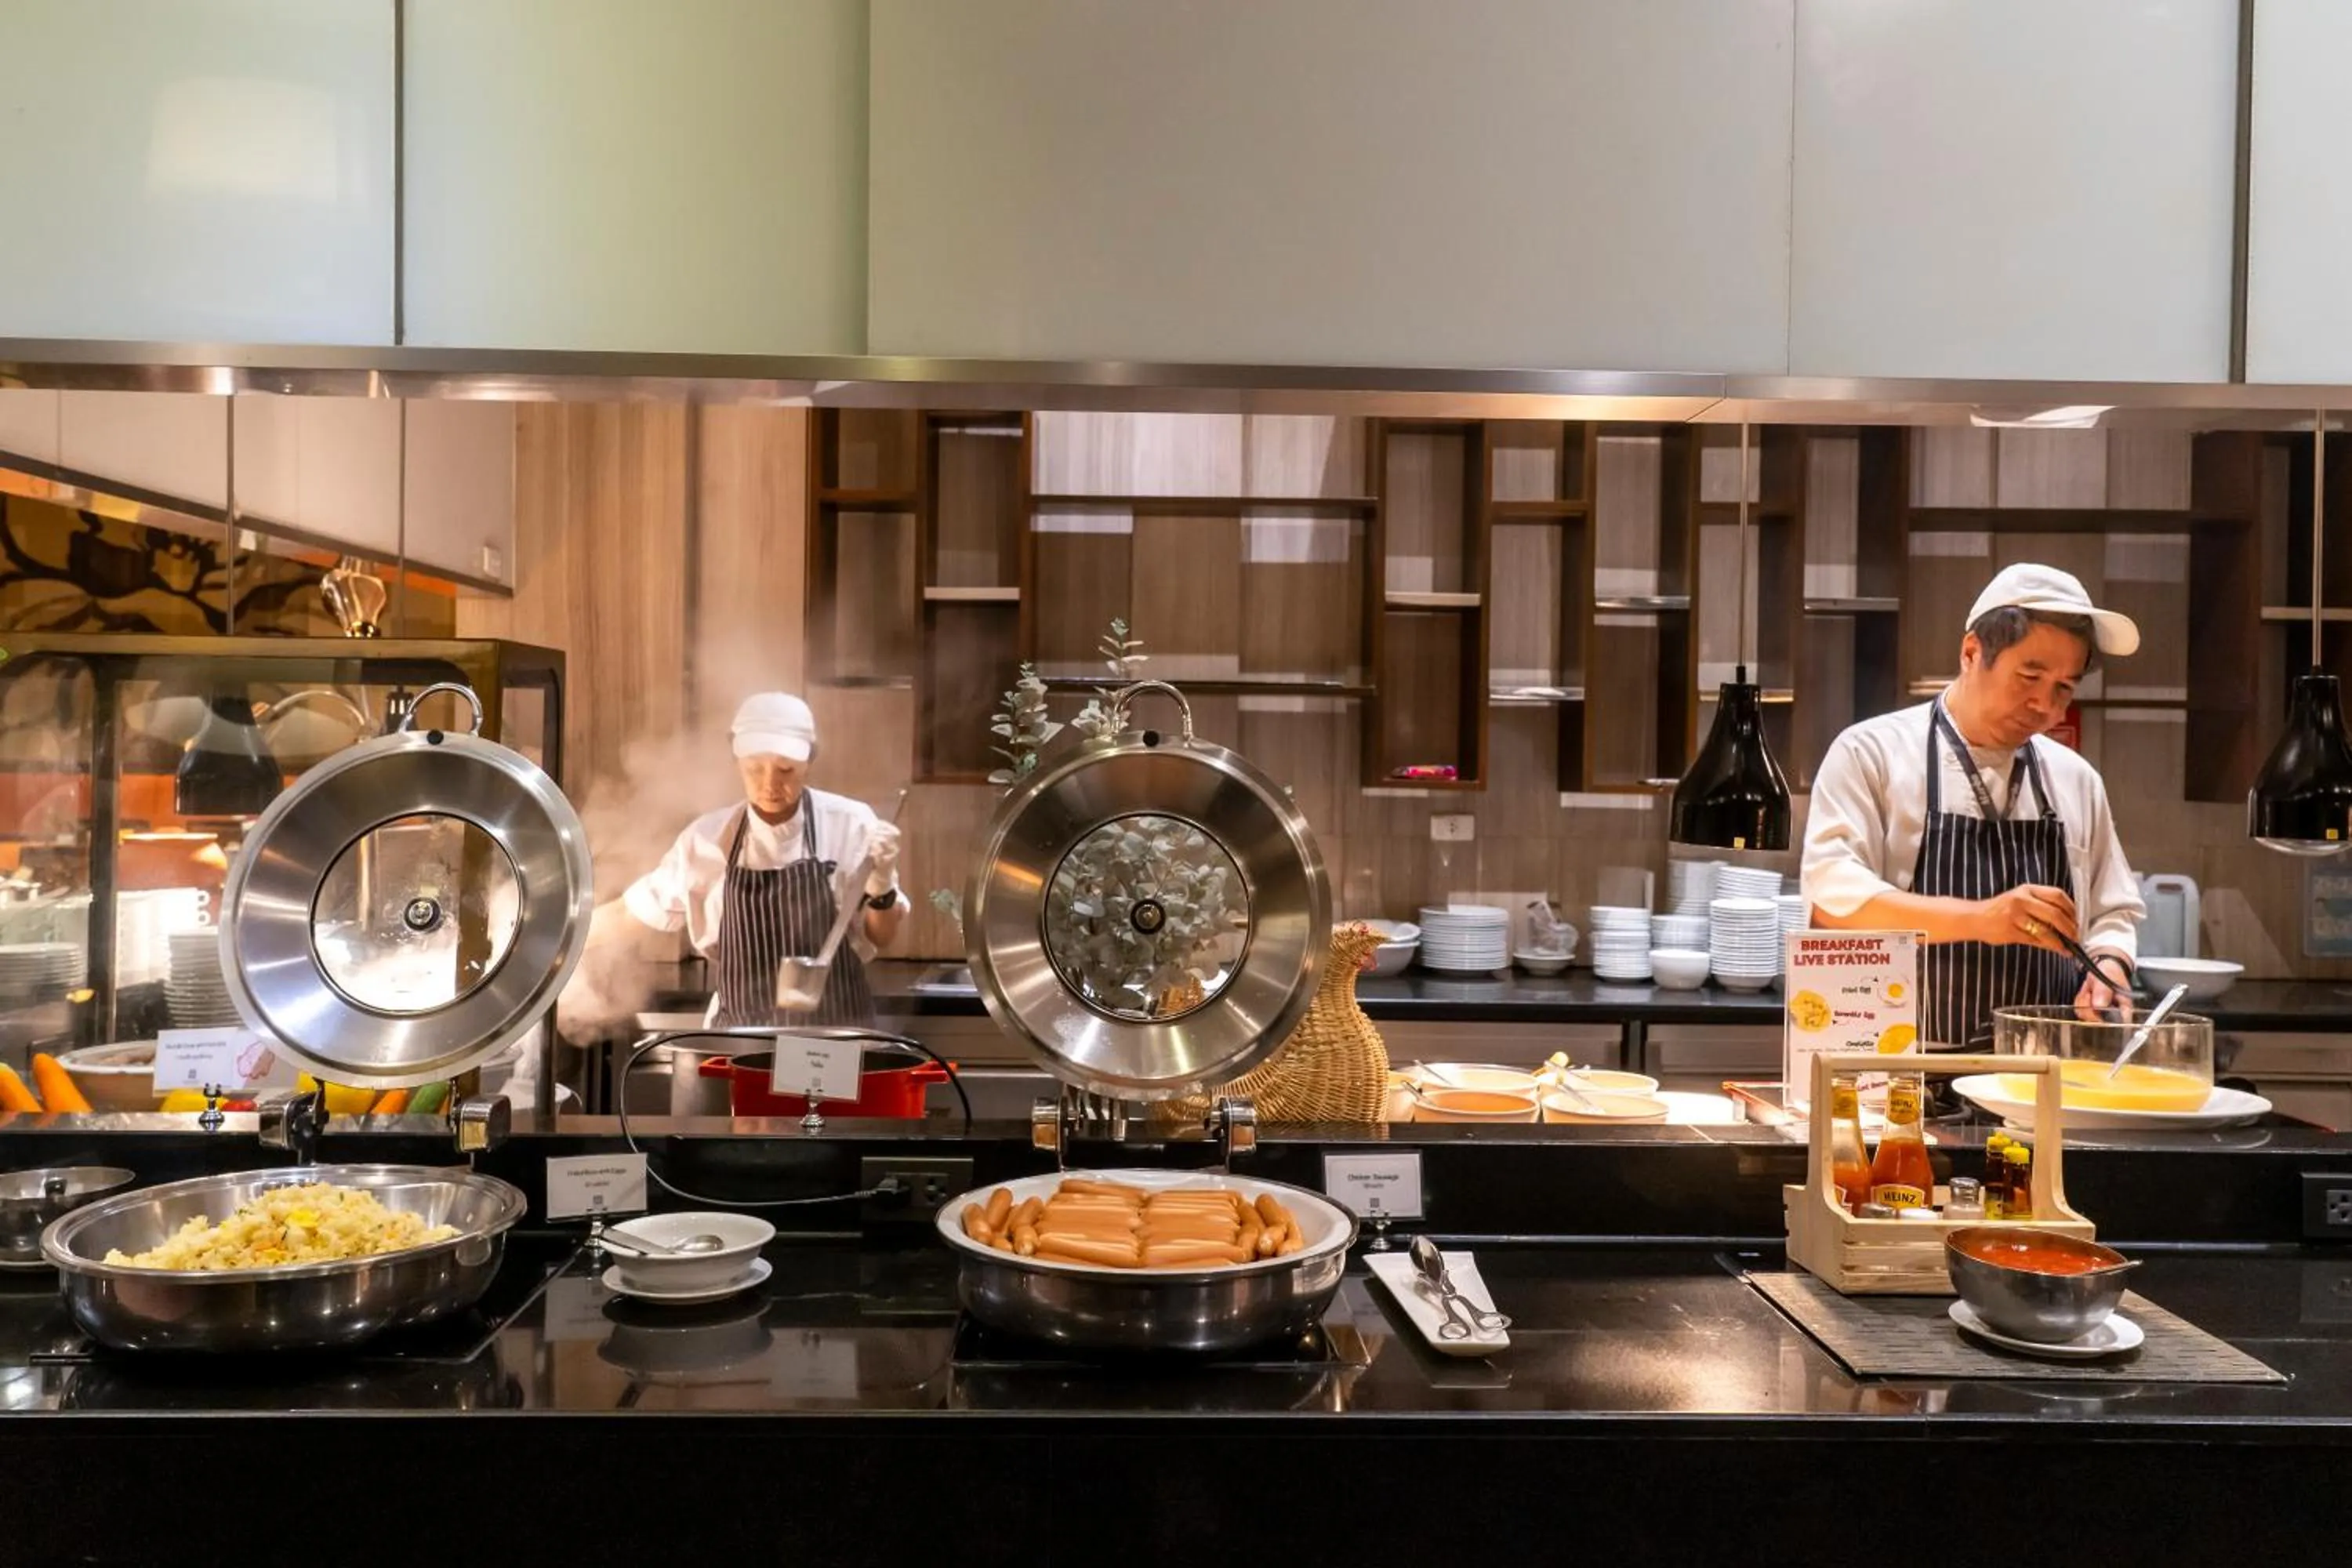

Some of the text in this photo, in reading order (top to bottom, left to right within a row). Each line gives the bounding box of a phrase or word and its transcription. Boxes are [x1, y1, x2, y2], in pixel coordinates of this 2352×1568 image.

[1801, 938, 1884, 951] BREAKFAST
[1793, 953, 1890, 966] LIVE STATION
[1883, 1191, 1916, 1205] HEINZ
